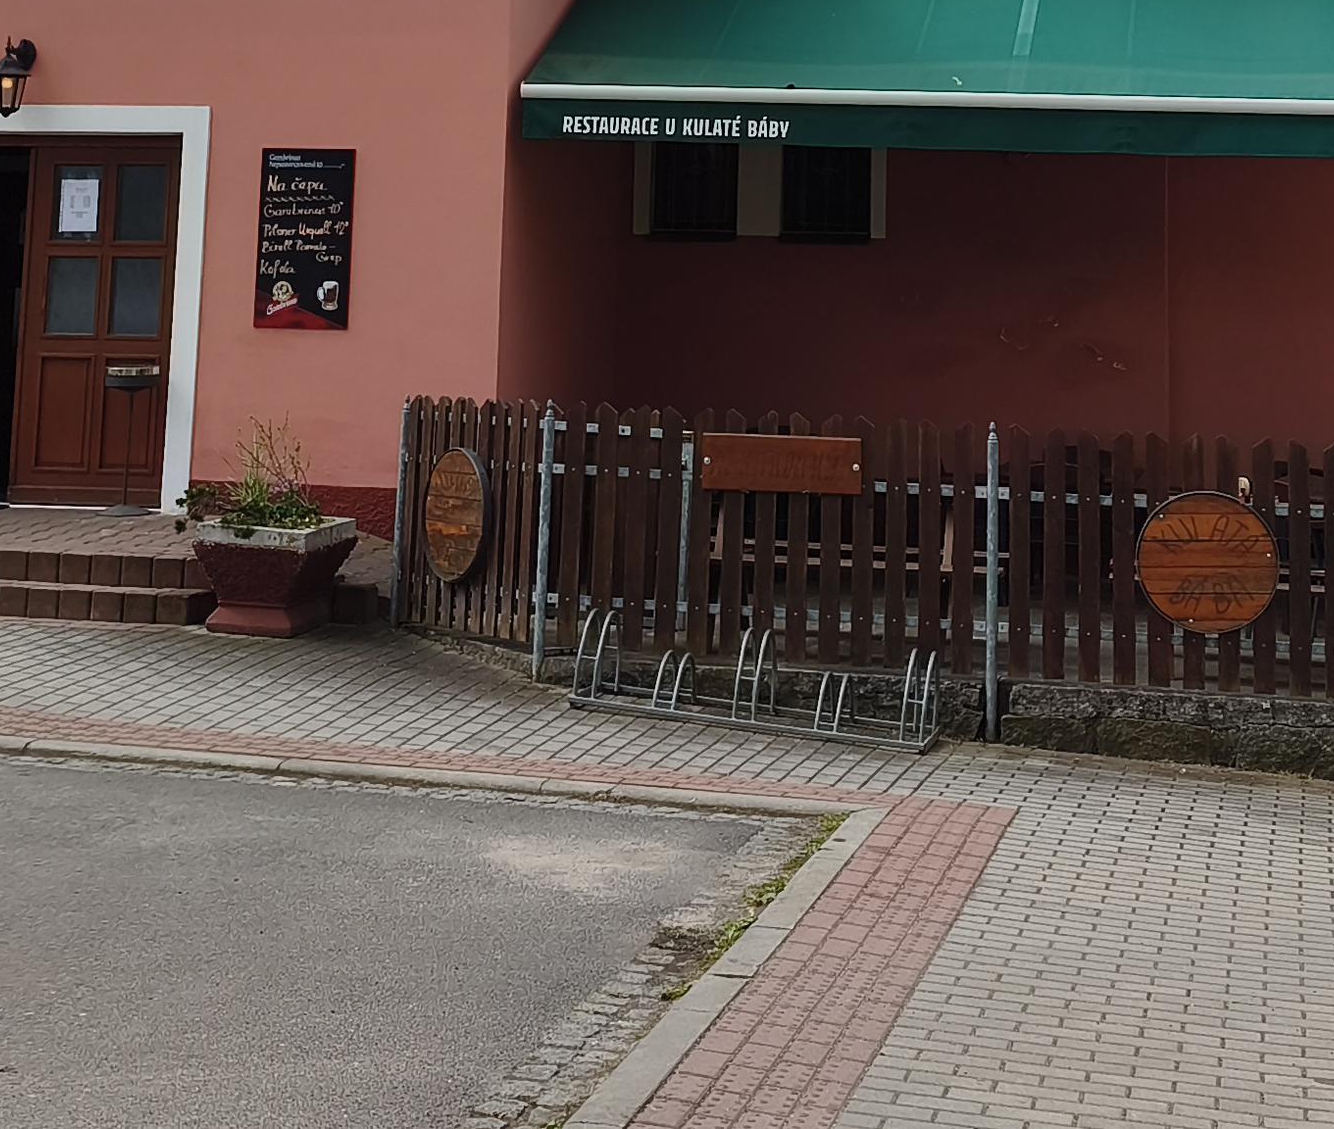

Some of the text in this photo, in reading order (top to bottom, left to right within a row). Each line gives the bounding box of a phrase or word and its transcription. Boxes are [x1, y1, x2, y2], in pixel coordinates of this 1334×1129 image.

[562, 115, 790, 138] RESTAURACE U KULATÉ BÁBY
[268, 175, 327, 194] Na čapu
